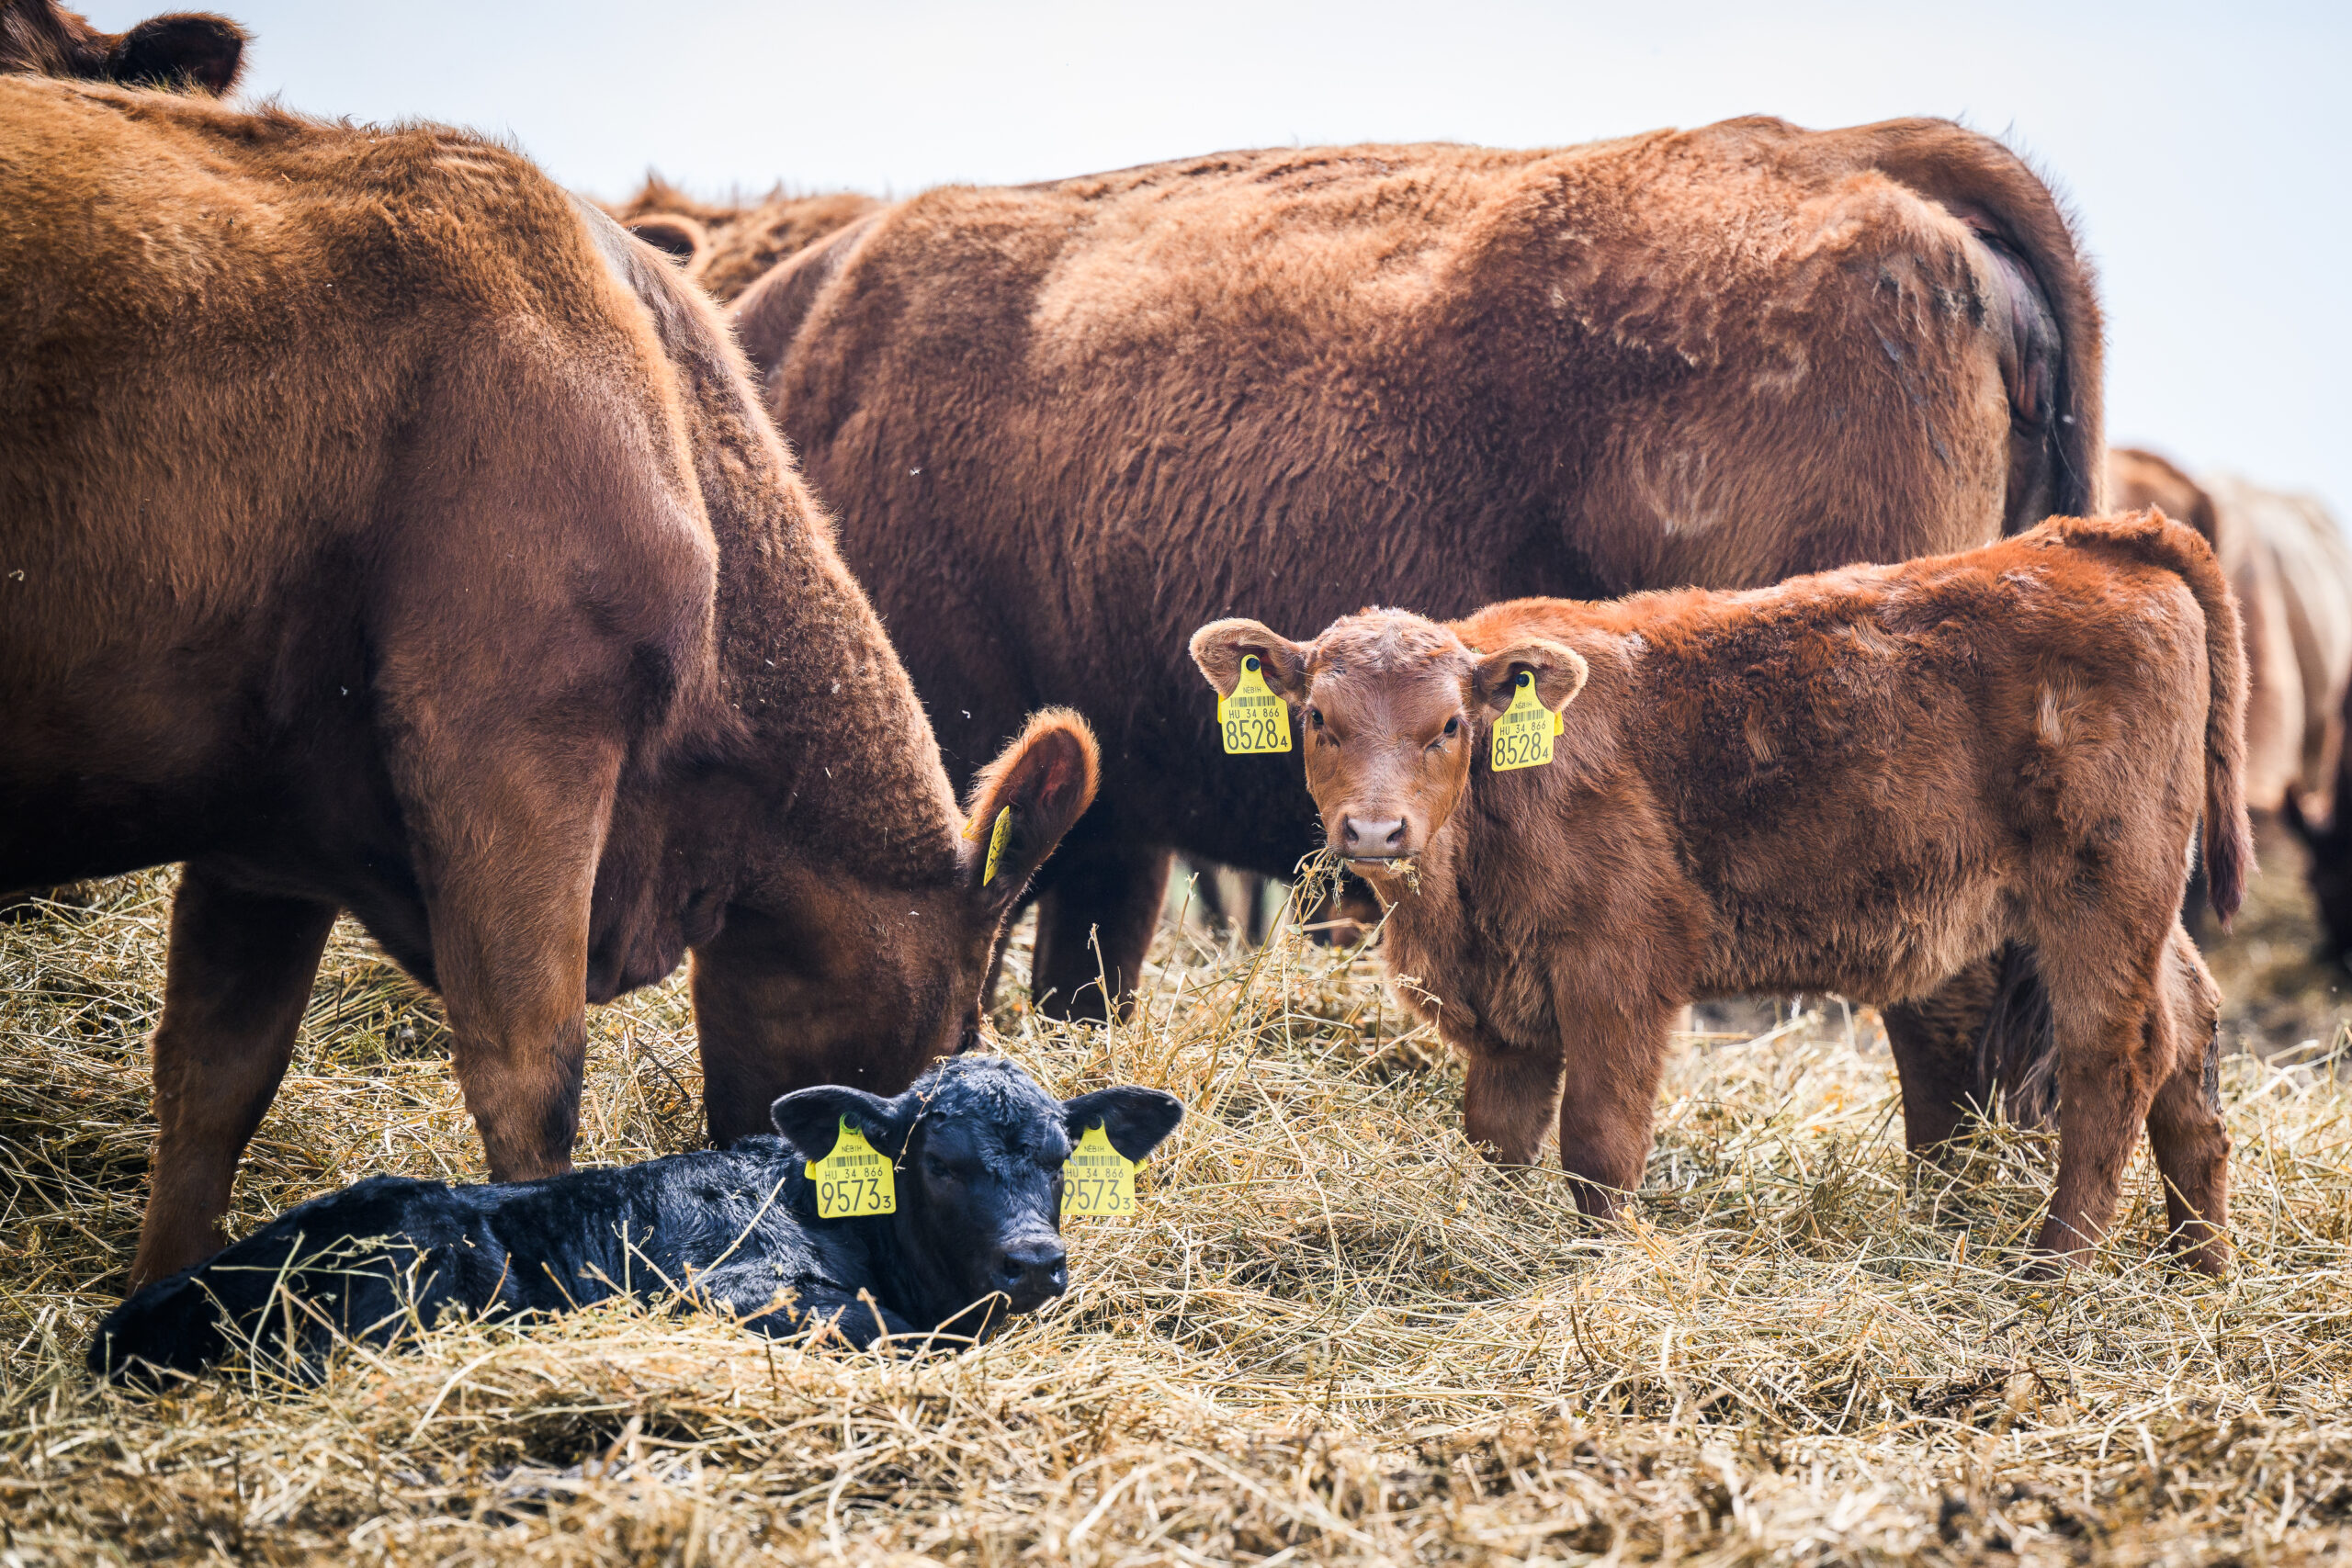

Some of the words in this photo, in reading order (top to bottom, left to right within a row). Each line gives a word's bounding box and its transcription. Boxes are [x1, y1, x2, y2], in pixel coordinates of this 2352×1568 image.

[1229, 709, 1240, 719] HU
[1246, 708, 1257, 718] 34
[1263, 707, 1280, 717] 866
[1499, 727, 1510, 736] HU
[1516, 724, 1525, 734] 34
[1532, 720, 1546, 731] 866
[842, 1145, 862, 1153] NÉBIH
[824, 1170, 837, 1180] HU
[844, 1168, 856, 1179] 34
[864, 1167, 883, 1178] 866
[1067, 1168, 1079, 1178] HU
[1086, 1168, 1098, 1178] 34
[1105, 1168, 1125, 1178] 866
